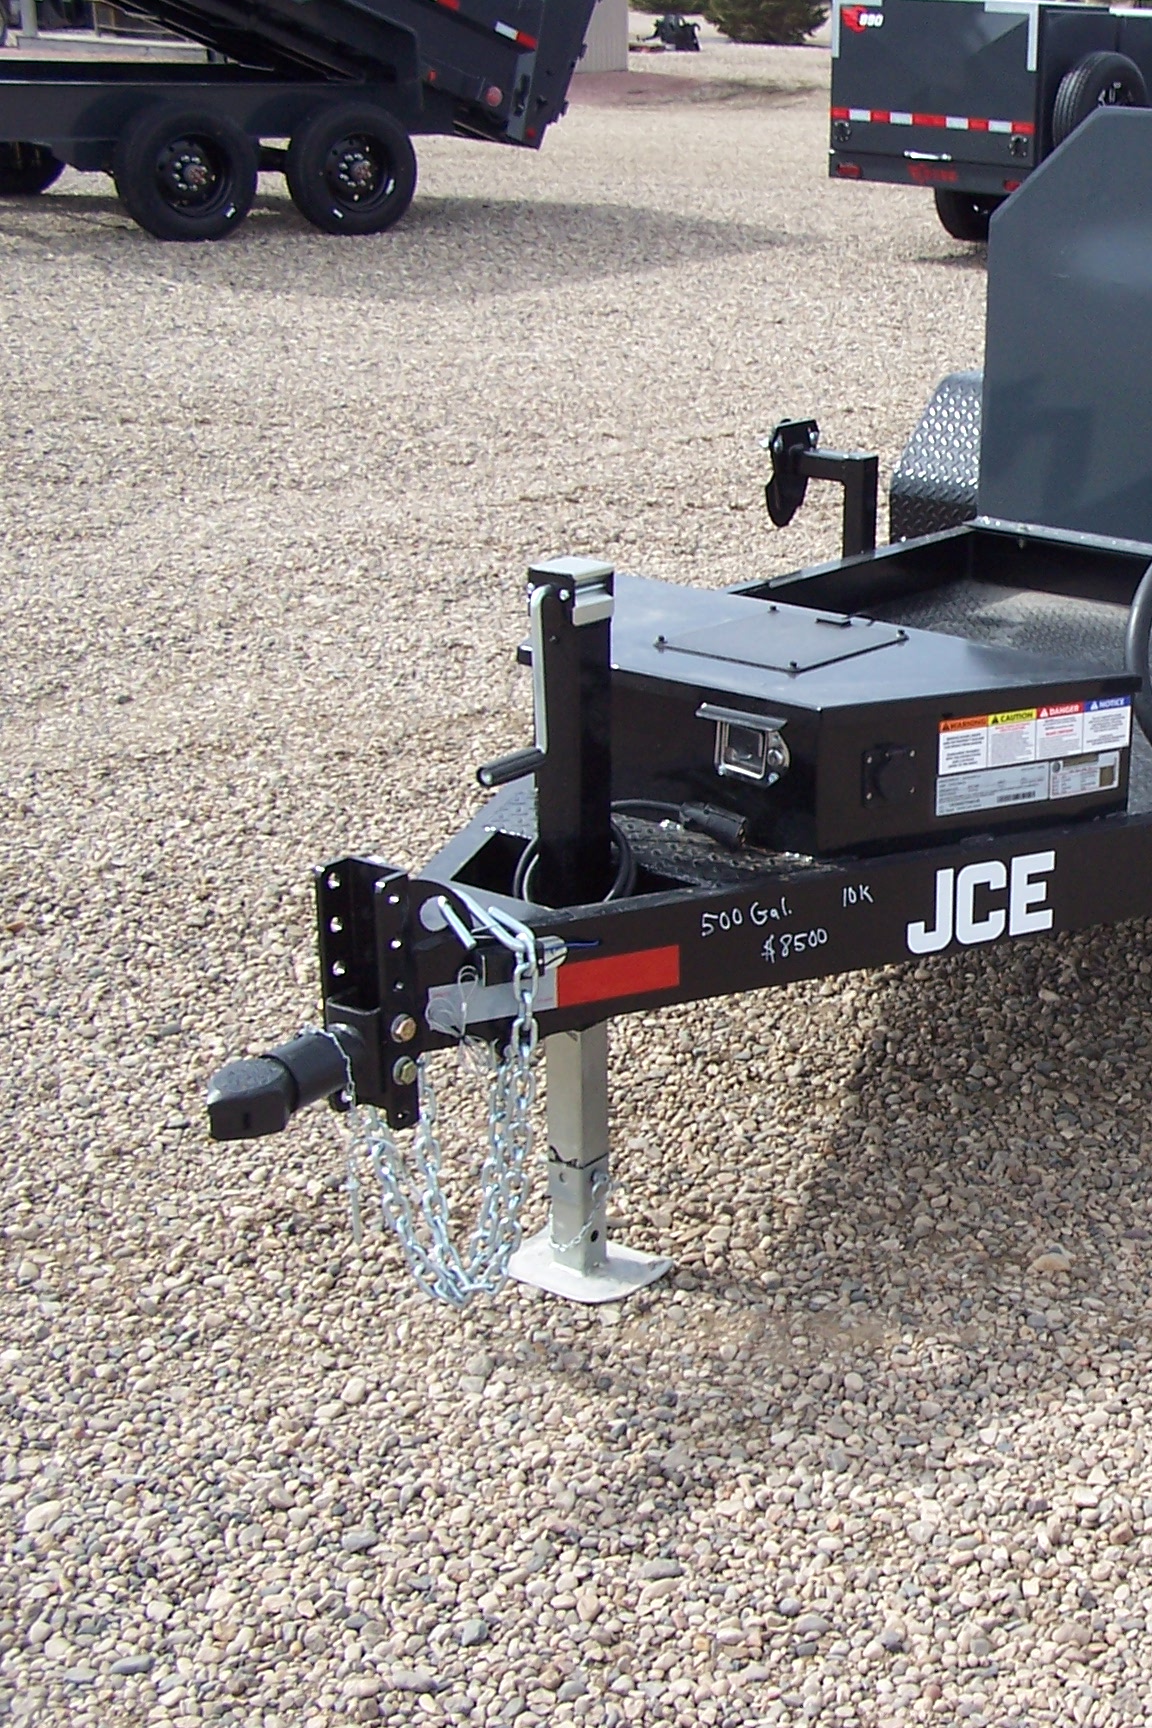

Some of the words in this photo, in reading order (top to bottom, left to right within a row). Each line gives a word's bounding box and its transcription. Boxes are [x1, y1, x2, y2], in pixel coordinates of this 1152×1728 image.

[1049, 704, 1080, 715] DANGER
[1099, 698, 1125, 707] NOTICE
[950, 717, 986, 730] WARNING
[1000, 711, 1033, 722] CAUTION
[842, 884, 874, 908] 10K
[907, 850, 1056, 954] JCE
[701, 908, 743, 937] 500
[750, 896, 793, 926] Gal.
[761, 928, 829, 964] $8500
